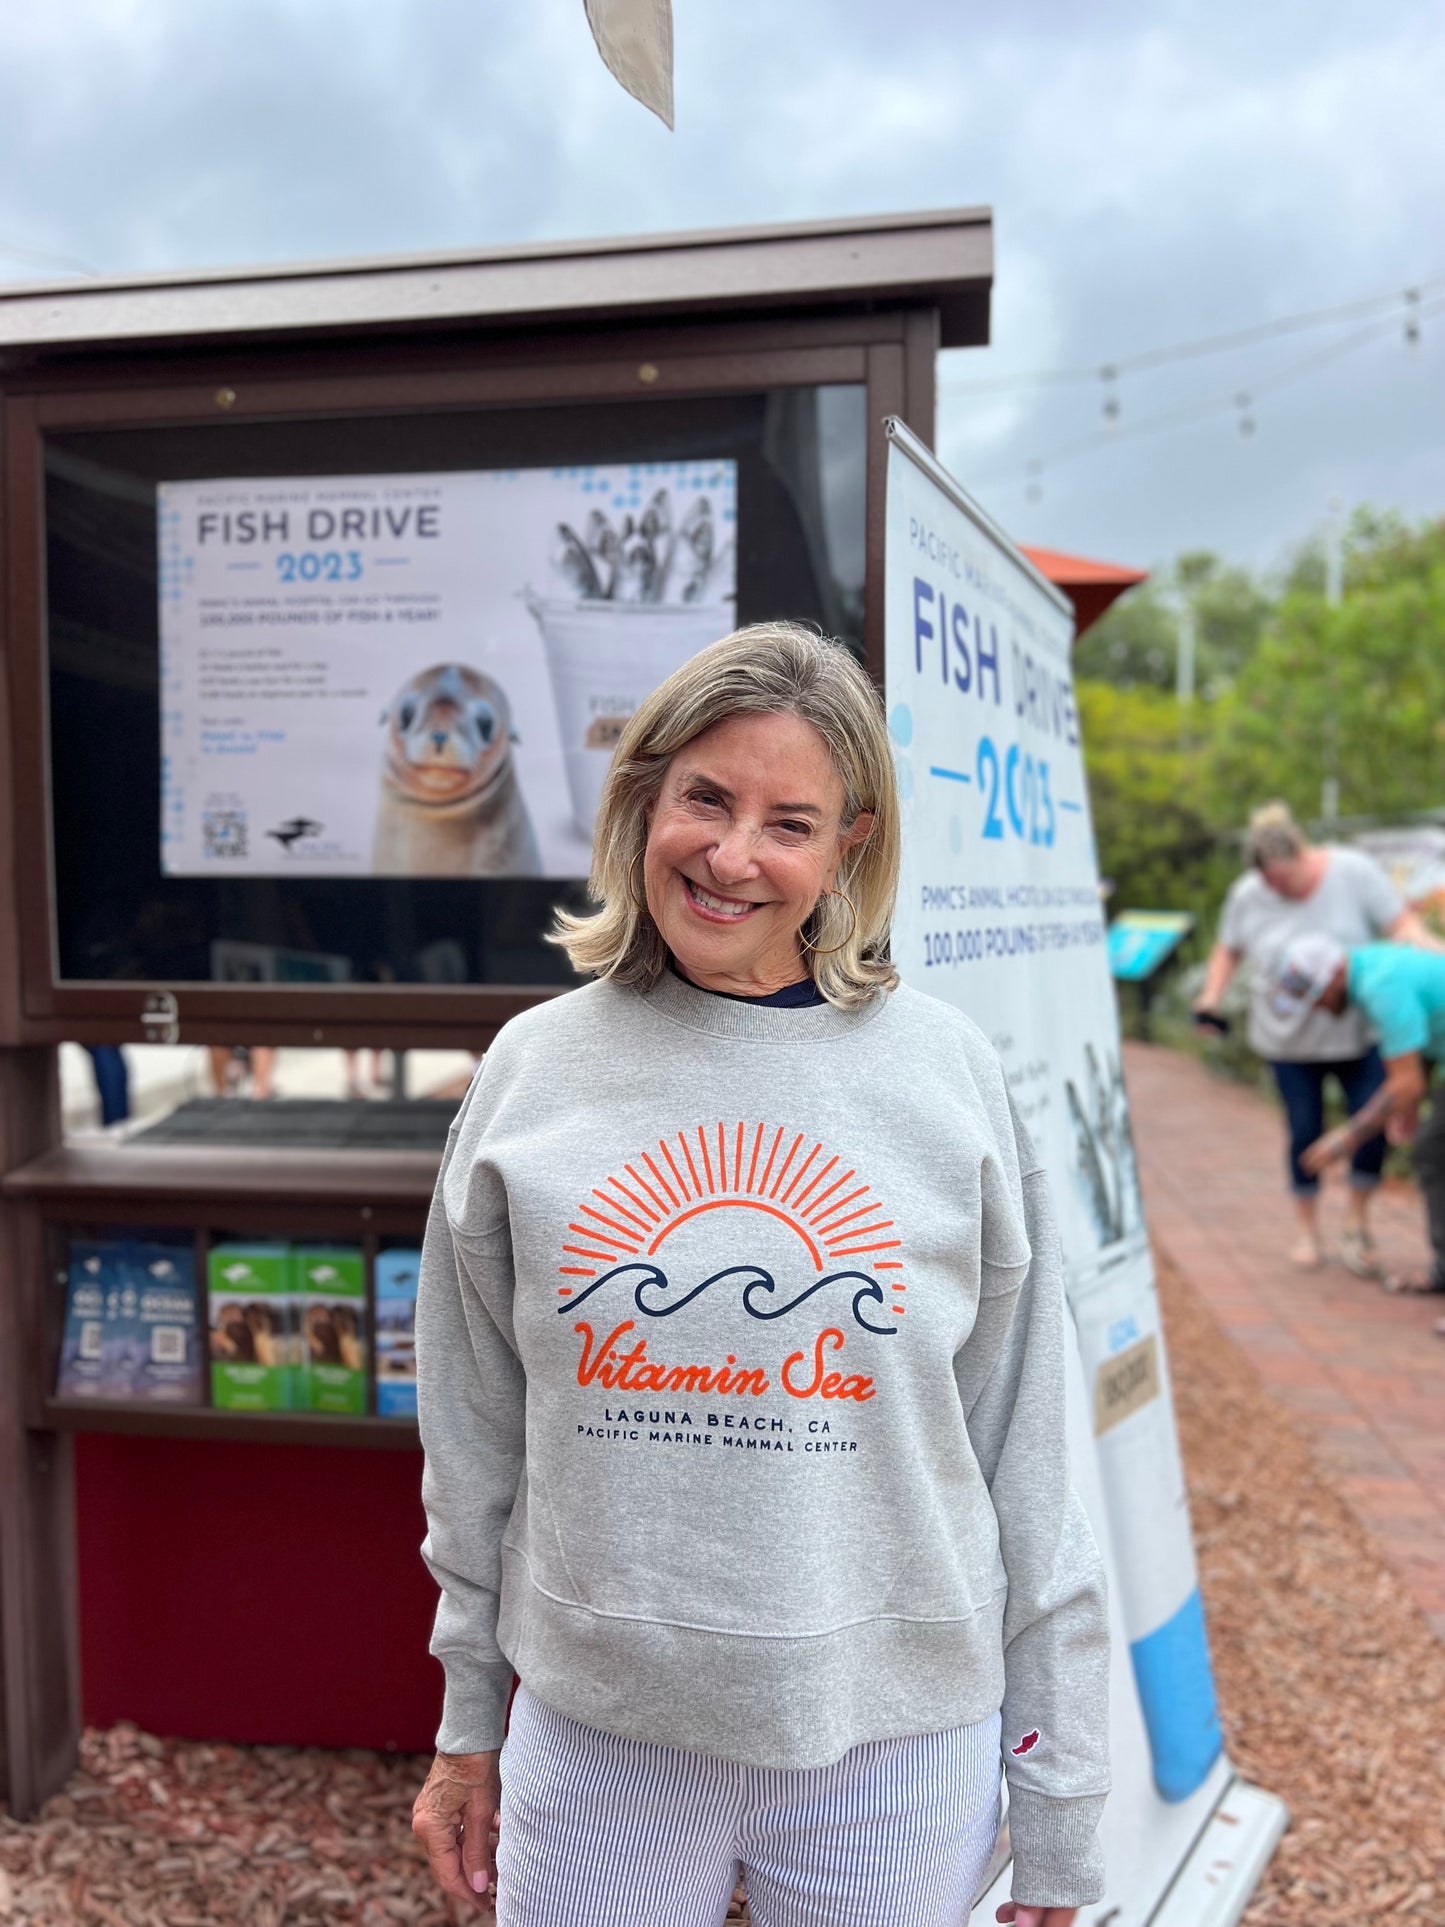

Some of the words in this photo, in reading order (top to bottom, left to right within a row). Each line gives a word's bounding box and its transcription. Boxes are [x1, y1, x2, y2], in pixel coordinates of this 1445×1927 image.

[198, 511, 289, 544] FISH
[308, 506, 440, 541] DRIVE
[276, 551, 363, 582] 2023
[914, 576, 998, 706] FISH
[924, 929, 982, 969] 100,000
[574, 1320, 769, 1396] Vitamin
[781, 1327, 876, 1402] Sea
[577, 1425, 640, 1441] PACIFIC
[649, 1431, 713, 1445] MARINE
[723, 1436, 794, 1452] MAMMAL
[804, 1441, 858, 1452] CENTER
[605, 1408, 693, 1425] LAGUNA
[707, 1413, 794, 1433] BEACH,
[808, 1420, 831, 1434] CA
